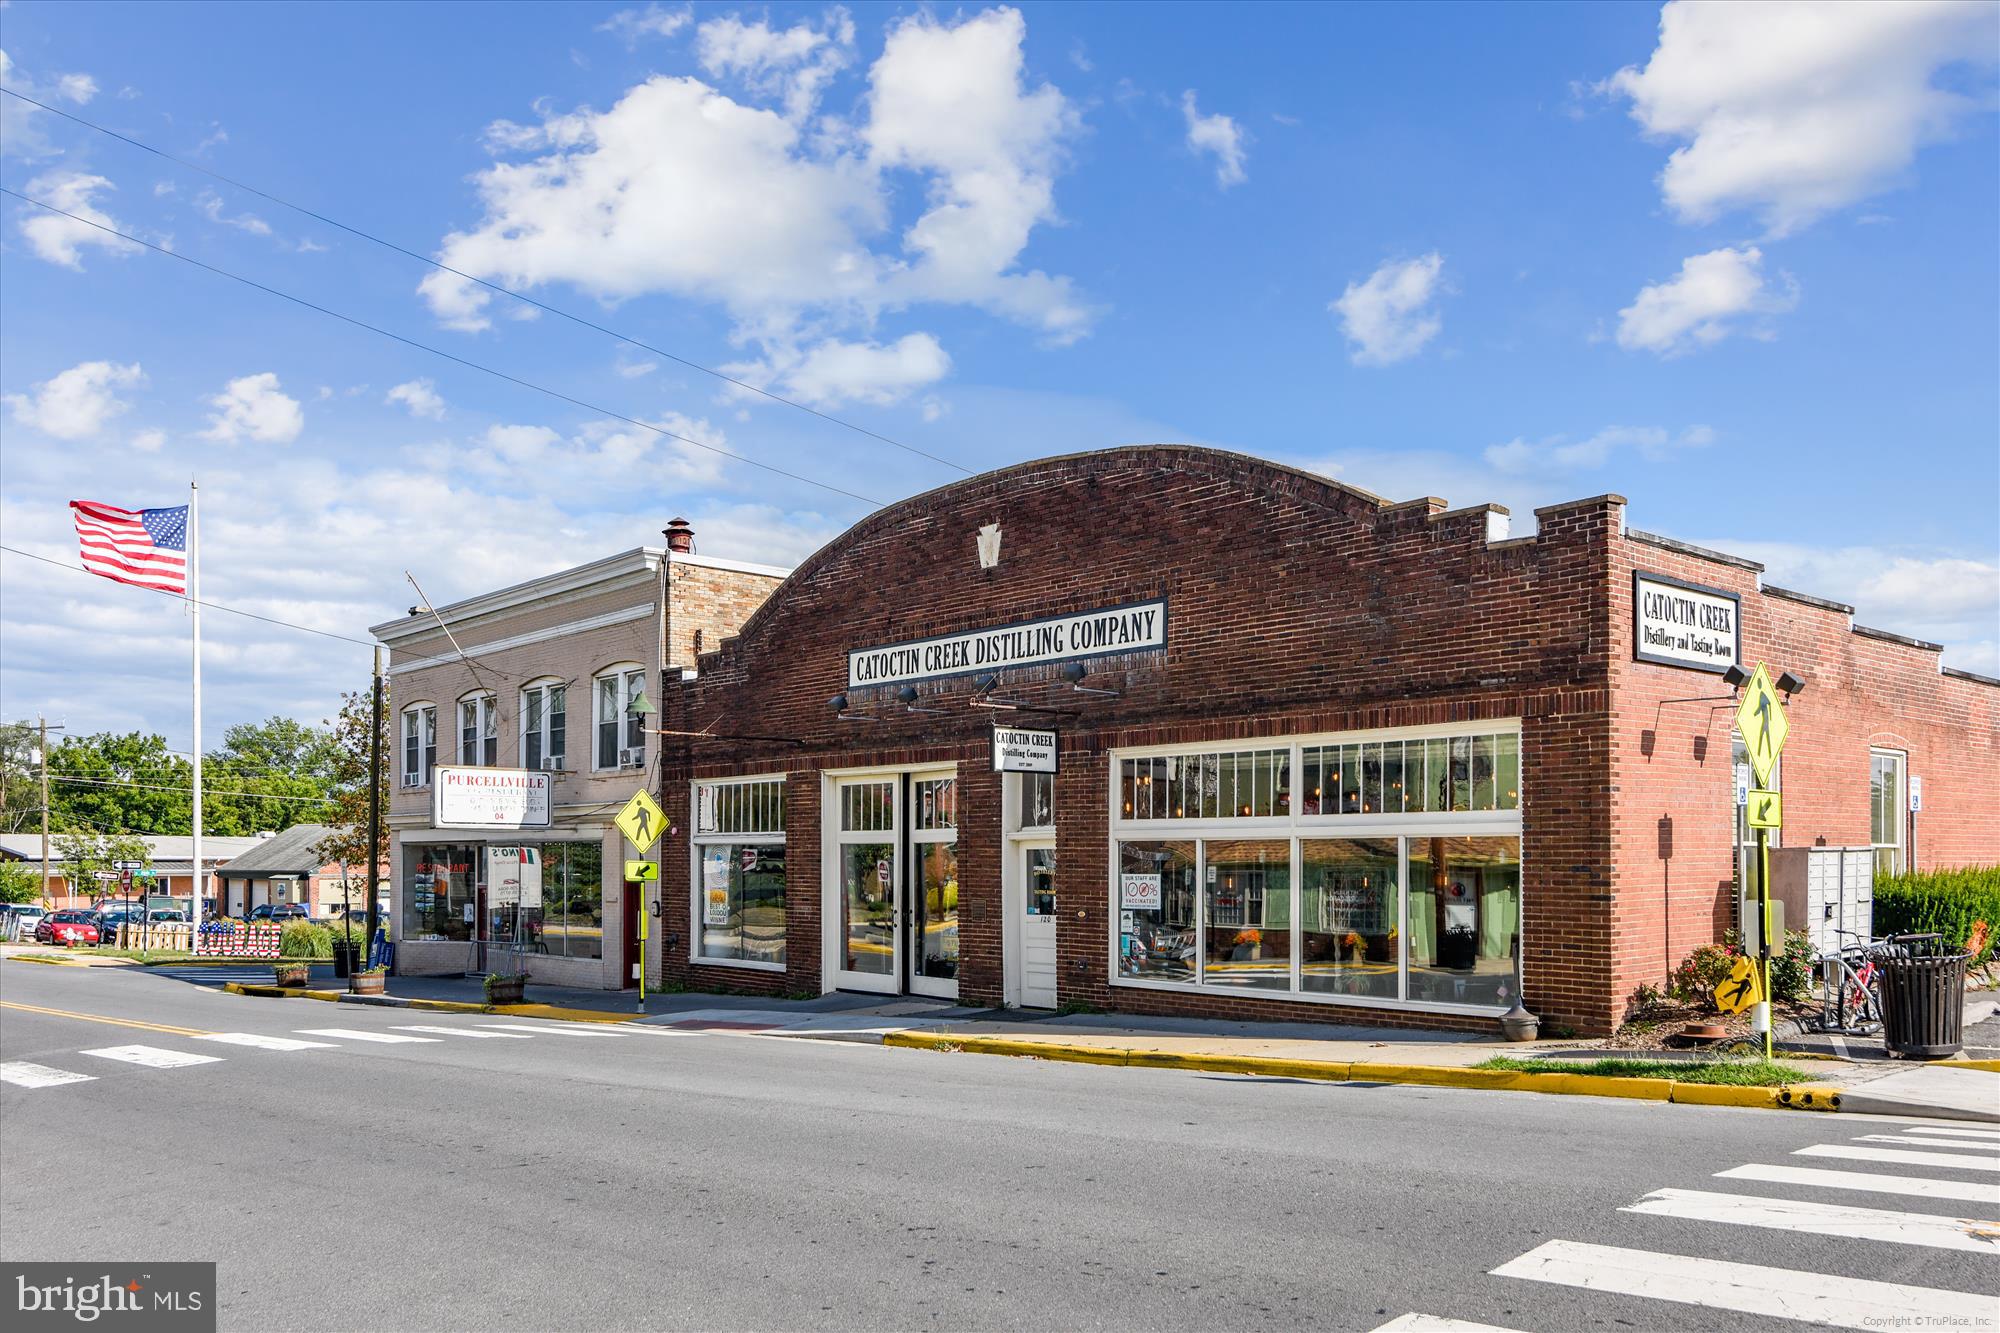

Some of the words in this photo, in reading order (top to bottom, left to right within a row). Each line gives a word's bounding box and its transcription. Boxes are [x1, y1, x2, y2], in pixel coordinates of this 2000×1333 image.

[1644, 591, 1696, 626] CATOCTIN
[1700, 603, 1731, 633] CREEK
[856, 648, 920, 681] CATOCTIN
[925, 640, 970, 672] CREEK
[975, 624, 1063, 664] DISTILLING
[1070, 610, 1156, 650] COMPANY
[1644, 625, 1675, 651] Distillery
[1677, 632, 1689, 650] and
[1690, 633, 1713, 657] Tasting
[1714, 638, 1731, 657] Room
[996, 732, 1030, 745] CATOCTIN
[1031, 734, 1053, 747] CREEK
[1002, 748, 1025, 758] Distilling
[1026, 749, 1048, 760] Company
[447, 774, 545, 789] PURCELLVILLE
[1125, 882, 1158, 897] 100%
[1040, 915, 1052, 923] 120
